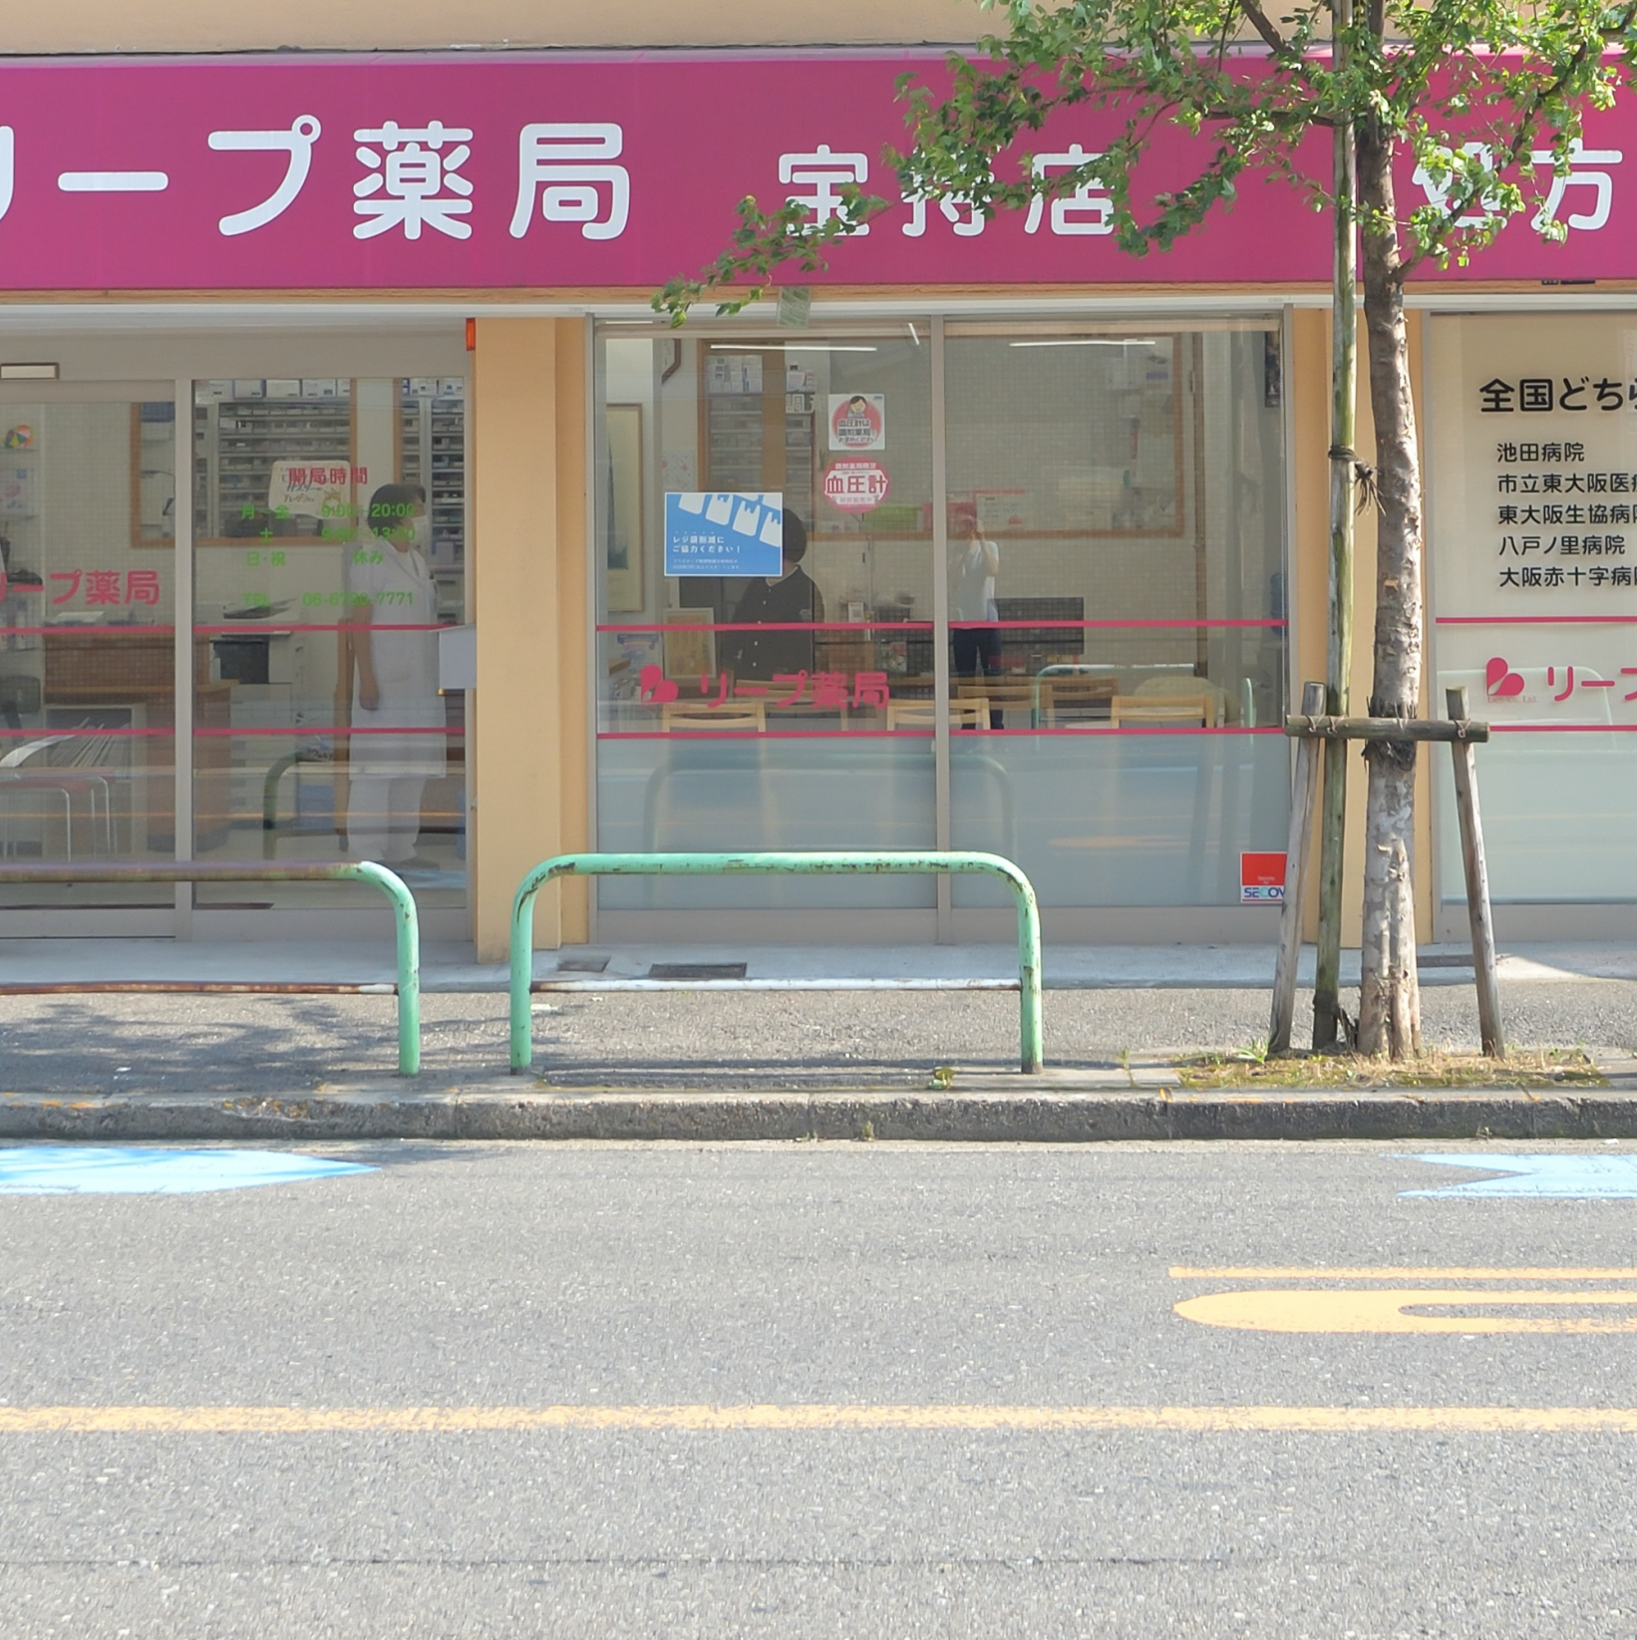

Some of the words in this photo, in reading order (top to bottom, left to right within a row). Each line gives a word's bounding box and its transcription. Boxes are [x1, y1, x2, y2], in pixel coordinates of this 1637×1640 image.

[1497, 442, 1585, 463] 池田病院
[288, 467, 368, 485] 開局時間
[826, 475, 887, 494] 血圧計
[1499, 534, 1626, 556] 八戸ノ里病院
[700, 670, 890, 709] リープ薬局
